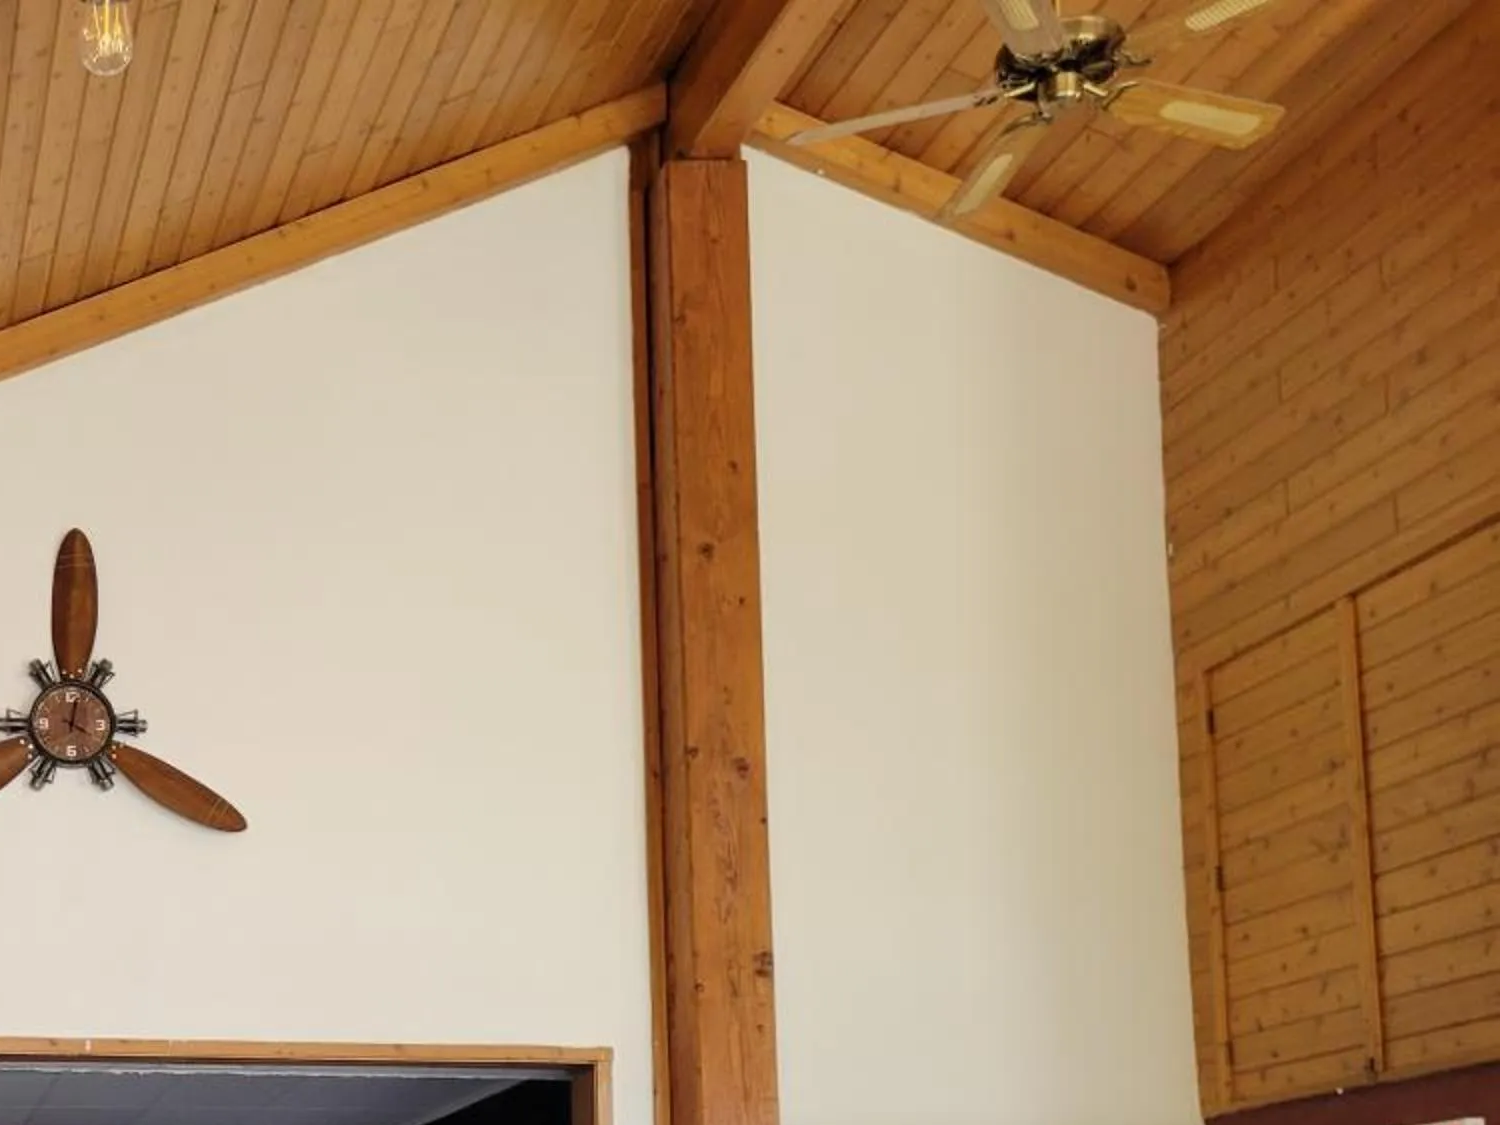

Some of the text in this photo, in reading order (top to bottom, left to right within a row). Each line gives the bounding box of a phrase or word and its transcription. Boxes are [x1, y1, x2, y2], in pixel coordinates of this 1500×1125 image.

[39, 717, 49, 729] 9
[95, 719, 105, 731] 3
[66, 745, 77, 757] 6
